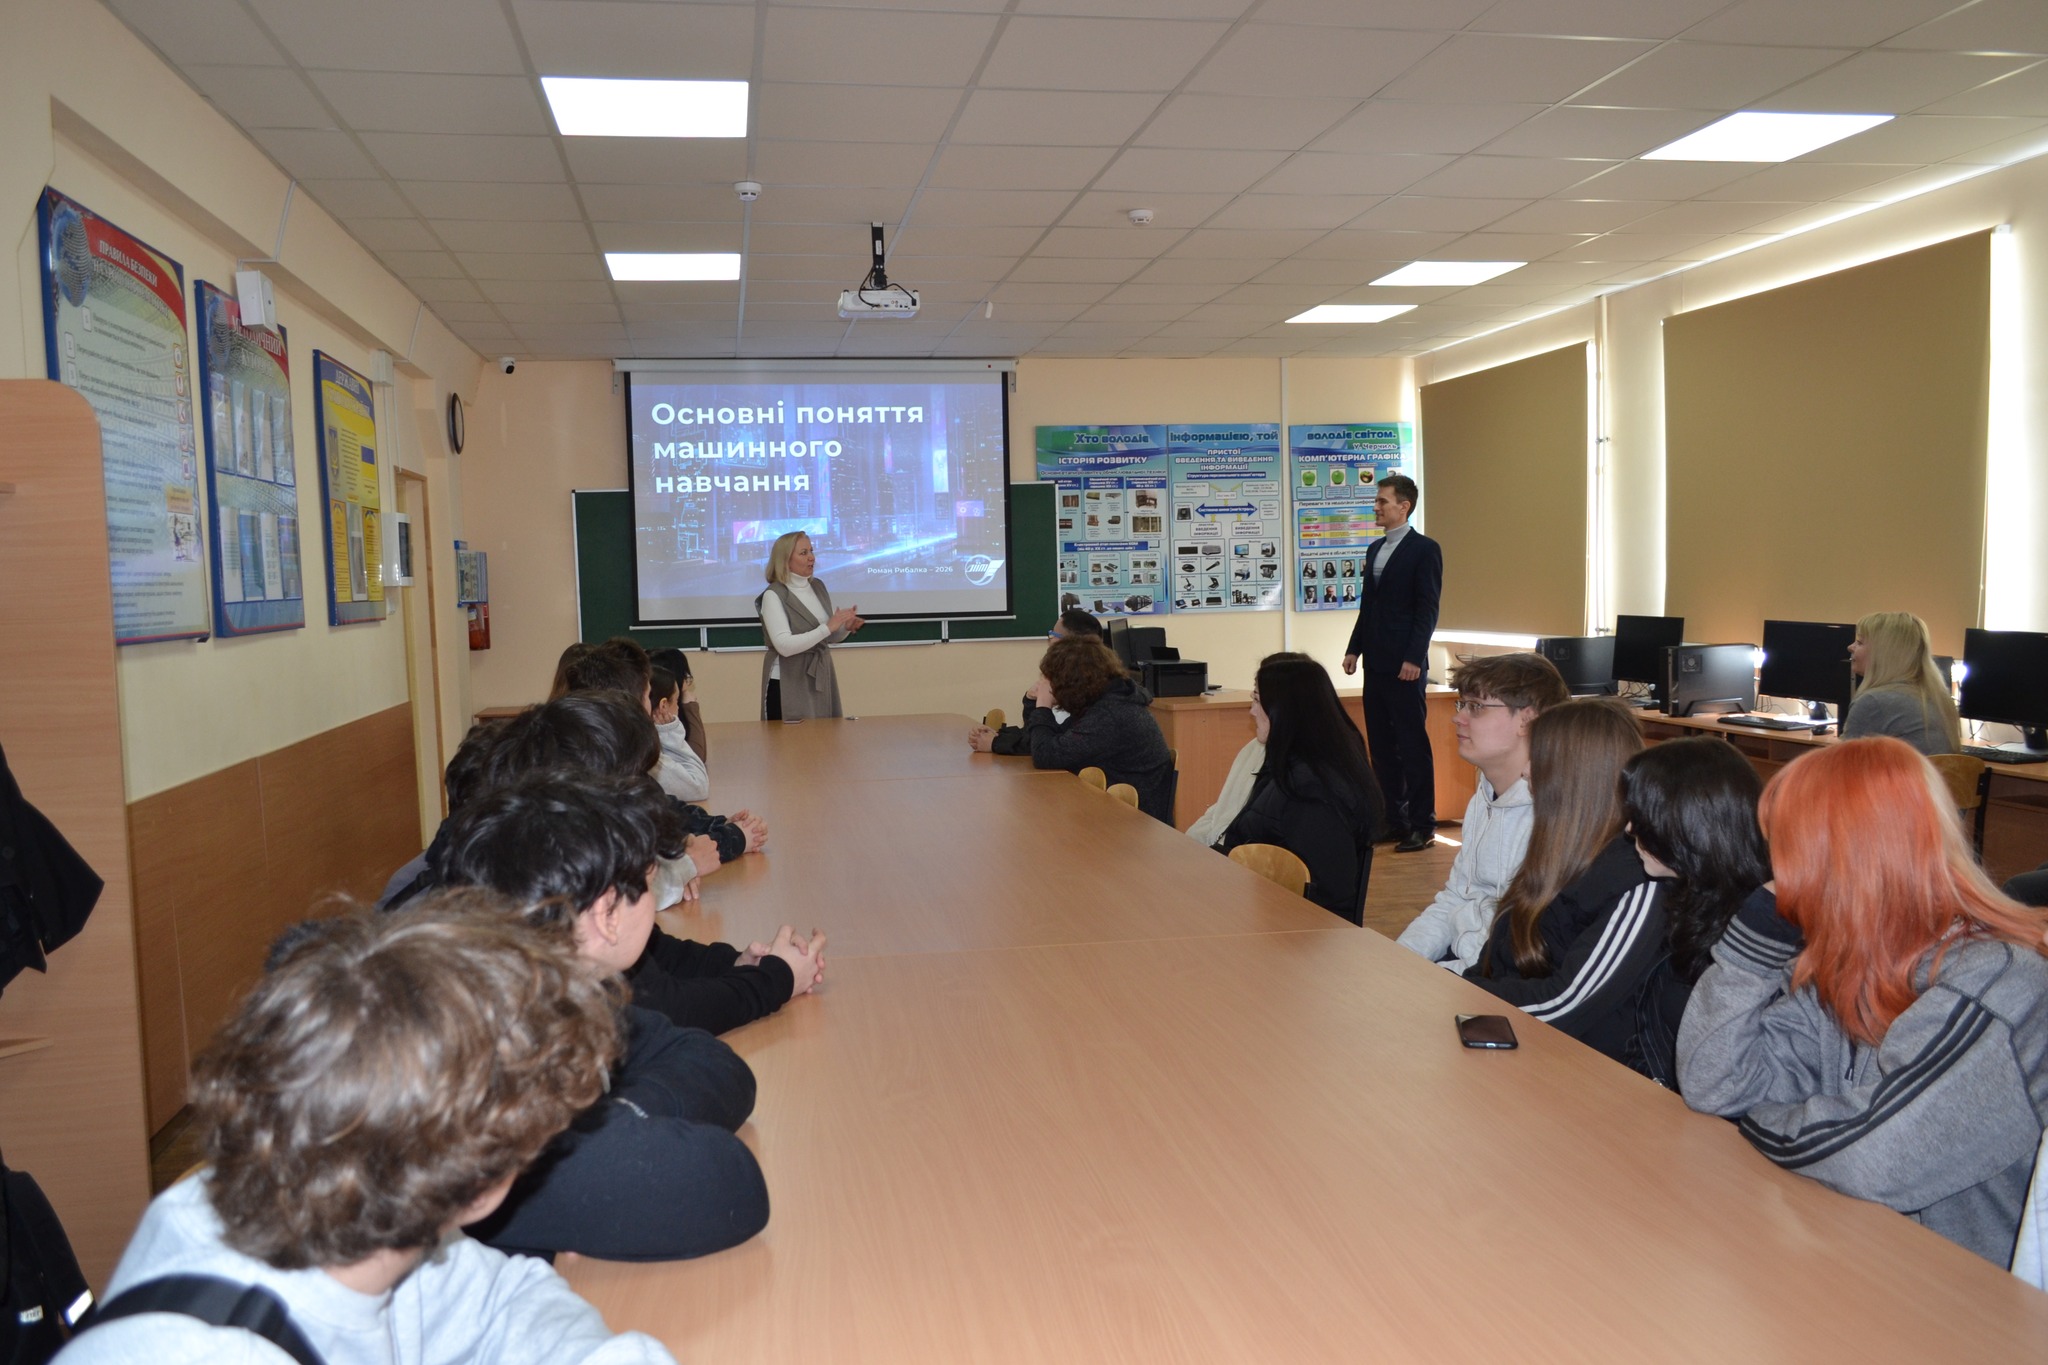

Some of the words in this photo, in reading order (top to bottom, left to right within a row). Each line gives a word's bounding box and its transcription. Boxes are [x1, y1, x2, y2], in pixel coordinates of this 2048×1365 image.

[99, 239, 131, 269] ПРАВИЛА
[130, 256, 158, 288] БЕЗПЕКИ
[651, 400, 785, 425] Основні
[797, 406, 924, 424] поняття
[1075, 433, 1099, 444] Хто
[1170, 431, 1254, 443] інформацією,
[1256, 430, 1279, 440] той
[1307, 430, 1352, 440] володіє
[1354, 429, 1397, 439] світом.
[654, 440, 843, 459] машинного
[1058, 457, 1095, 465] ІСТОРІЯ
[1096, 456, 1147, 464] РОЗВИТКУ
[655, 474, 810, 493] навчання
[894, 566, 928, 574] Рибалка
